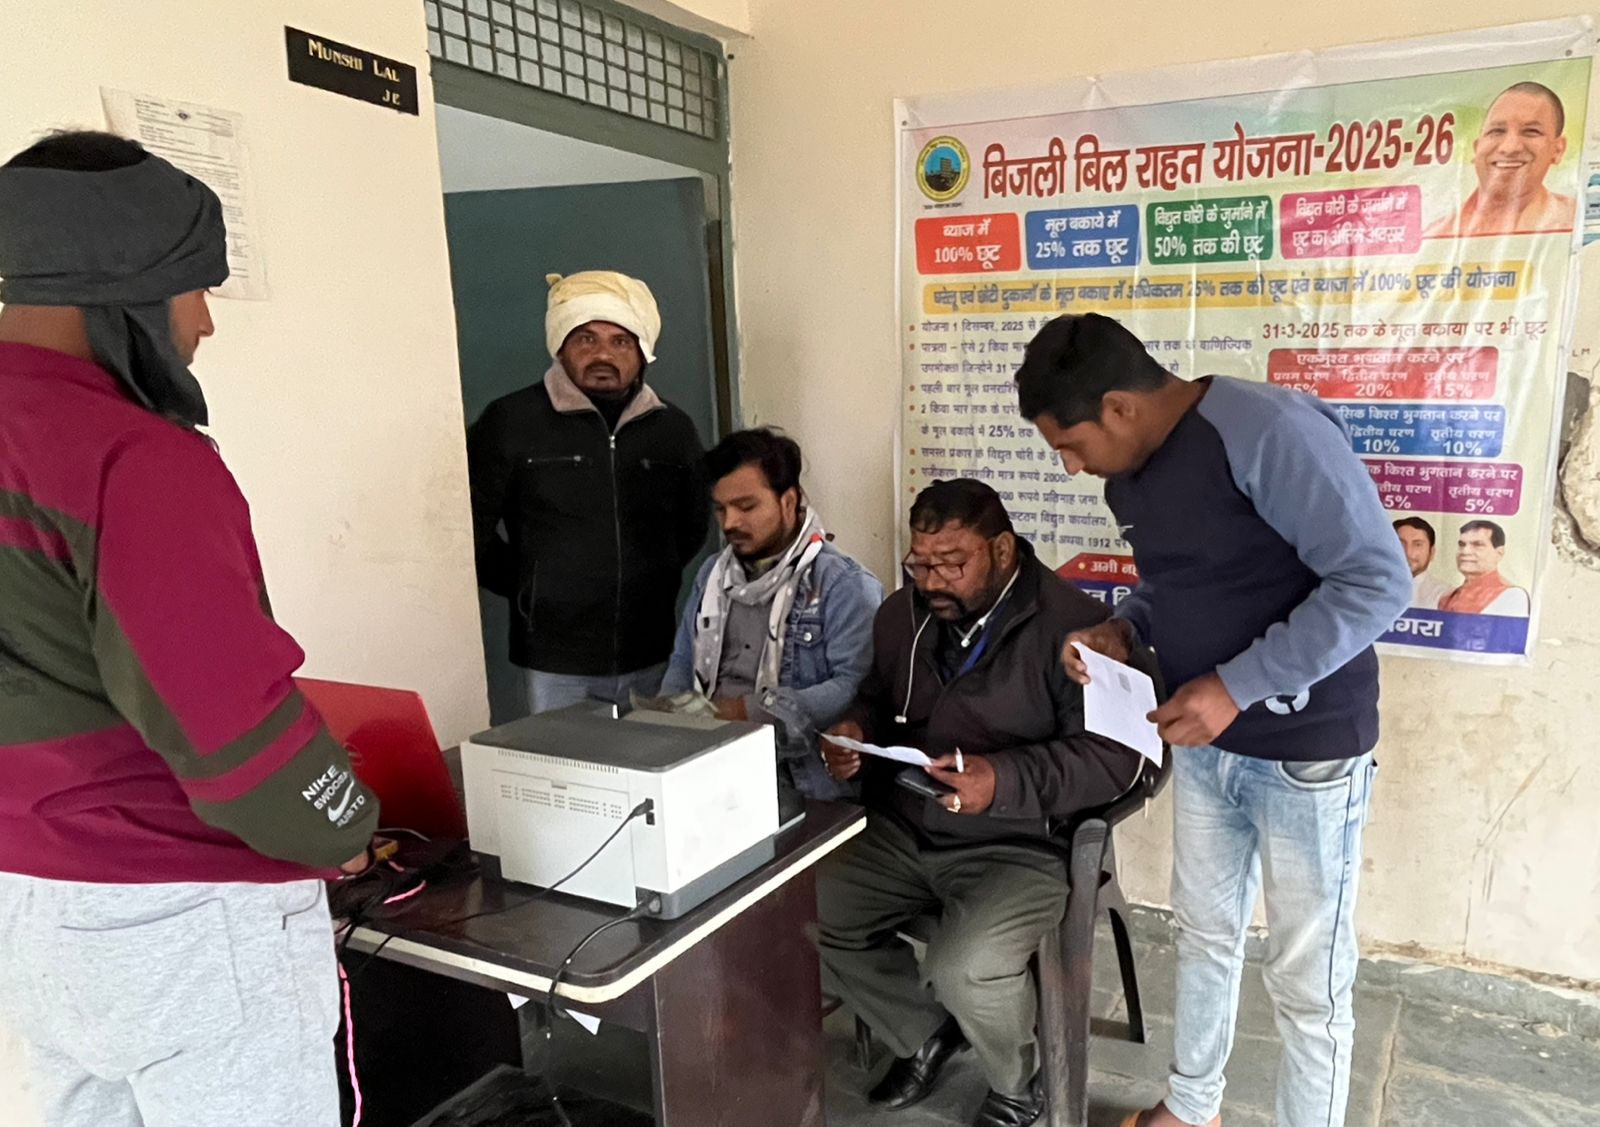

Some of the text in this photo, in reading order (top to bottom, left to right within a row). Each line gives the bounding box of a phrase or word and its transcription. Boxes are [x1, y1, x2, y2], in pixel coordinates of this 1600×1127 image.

[982, 136, 1067, 199] बिजली
[1074, 134, 1130, 193] बिल
[1136, 143, 1206, 191] राहत
[943, 218, 991, 238] ब्याज में
[1106, 210, 1121, 228] में
[1035, 237, 1129, 263] 25% तक छूट
[1154, 230, 1265, 261] 50% तक की छूट
[934, 244, 1001, 269] 100% छूट
[1220, 281, 1242, 296] तक
[1313, 276, 1348, 293] ब्याज
[1370, 272, 1411, 291] 100%
[1466, 266, 1516, 287] योजना
[1001, 321, 1024, 331] 2025
[1344, 323, 1367, 337] तक
[1372, 319, 1386, 336] के
[1422, 322, 1468, 337] बकाया
[1475, 321, 1494, 335] पर
[1355, 382, 1473, 398] 20% 15%
[989, 426, 1015, 438] 25%
[1362, 438, 1483, 456] 10% 10%
[1464, 499, 1494, 513] 5%
[1088, 537, 1110, 548] 1912
[302, 765, 339, 801] NIKE
